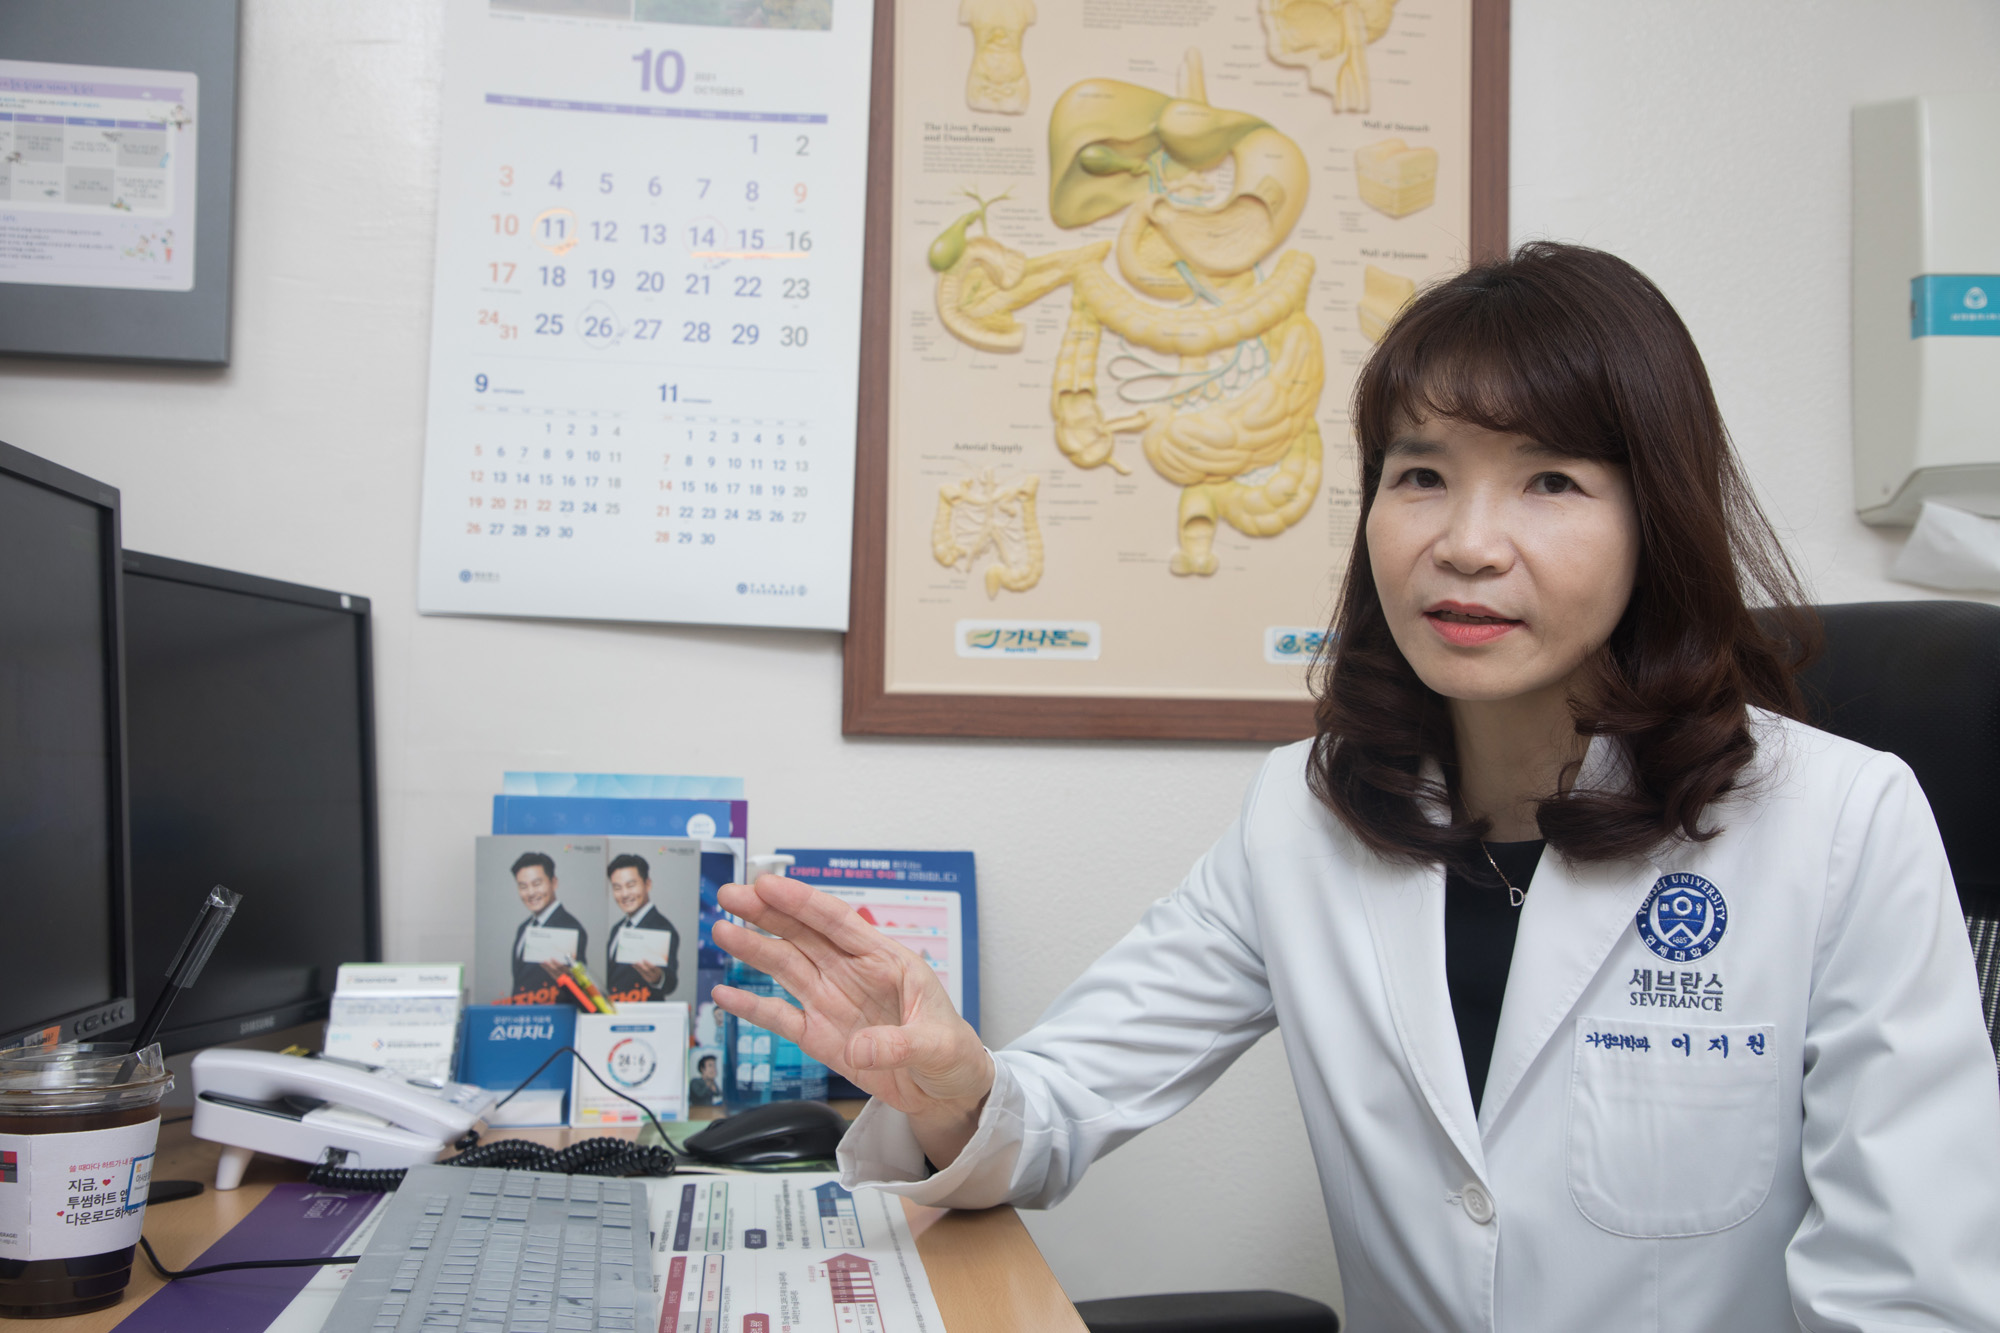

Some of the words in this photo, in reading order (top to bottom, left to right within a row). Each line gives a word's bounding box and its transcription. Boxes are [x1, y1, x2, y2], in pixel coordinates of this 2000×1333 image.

[632, 48, 685, 94] 10
[694, 86, 744, 96] OCTOBER
[749, 134, 758, 154] 1
[796, 135, 809, 156] 2
[499, 165, 514, 187] 3
[549, 170, 563, 190] 4
[600, 173, 613, 194] 5
[648, 176, 662, 197] 6
[697, 178, 711, 199] 7
[745, 181, 759, 202] 8
[794, 182, 808, 204] 9
[491, 213, 519, 236] 10
[539, 219, 565, 238] 11
[591, 221, 617, 242] 12
[640, 224, 666, 245] 13
[689, 226, 715, 247] 14
[738, 229, 764, 250] 15
[786, 231, 812, 252] 16
[489, 262, 517, 283] 17
[539, 266, 566, 287] 18
[589, 269, 615, 289] 19
[636, 271, 664, 293] 20
[685, 273, 710, 295] 21
[734, 276, 762, 297] 22
[783, 278, 810, 299] 23
[478, 310, 498, 325] 24
[535, 313, 563, 335] 25
[585, 316, 613, 338] 26
[634, 318, 662, 340] 27
[683, 321, 710, 343] 28
[732, 323, 759, 345] 29
[780, 326, 808, 347] 30
[499, 325, 518, 340] 31
[475, 373, 488, 393] 9
[659, 384, 677, 402] 11
[546, 422, 551, 434] 1
[568, 423, 576, 435] 2
[590, 424, 598, 436] 3
[613, 426, 620, 436] 4
[688, 430, 693, 440] 1
[709, 431, 717, 442] 2
[732, 432, 739, 443] 3
[754, 434, 761, 443] 4
[777, 434, 784, 445] 5
[799, 436, 807, 446] 6
[475, 444, 482, 456] 5
[497, 446, 505, 457] 6
[521, 446, 529, 458] 7
[543, 448, 551, 459] 8
[566, 449, 574, 461] 9
[586, 450, 601, 462] 10
[609, 452, 621, 462] 11
[954, 441, 988, 452] Arterial
[991, 442, 1023, 455] Supply
[664, 454, 670, 465] 7
[685, 455, 693, 466] 8
[708, 456, 716, 468] 9
[728, 457, 742, 469] 10
[751, 458, 763, 469] 11
[773, 459, 786, 471] 12
[795, 460, 809, 472] 13
[470, 470, 484, 483] 12
[493, 472, 507, 483] 13
[517, 473, 530, 483] 14
[540, 474, 553, 486] 15
[562, 475, 576, 487] 16
[585, 476, 599, 487] 17
[608, 477, 621, 489] 18
[659, 480, 672, 490] 14
[682, 481, 695, 492] 15
[705, 482, 718, 493] 16
[727, 483, 740, 494] 17
[750, 484, 762, 495] 18
[772, 485, 785, 496] 19
[793, 486, 808, 498] 20
[469, 497, 483, 508] 19
[491, 497, 506, 509] 20
[514, 498, 527, 510] 21
[537, 499, 552, 512] 22
[560, 500, 574, 512] 23
[583, 502, 597, 513] 24
[605, 503, 620, 515] 25
[657, 505, 670, 517] 21
[679, 506, 694, 518] 22
[702, 507, 716, 519] 23
[725, 509, 739, 520] 24
[747, 509, 762, 521] 25
[770, 510, 784, 522] 26
[792, 511, 807, 523] 27
[467, 522, 481, 534] 26
[490, 523, 504, 535] 27
[512, 524, 527, 536] 28
[536, 526, 550, 537] 29
[558, 526, 573, 538] 30
[656, 531, 670, 543] 28
[678, 532, 692, 544] 29
[701, 533, 715, 545] 30
[1671, 874, 1726, 921] UNIVERSITY
[1645, 934, 1716, 961] 연세대학교
[1629, 968, 1724, 996] 세브란스
[1630, 991, 1723, 1012] SEVERANCE
[1585, 1031, 1651, 1053] 가정의학과
[68, 1178, 98, 1192] 지금,
[67, 1191, 117, 1209] 투썸하트
